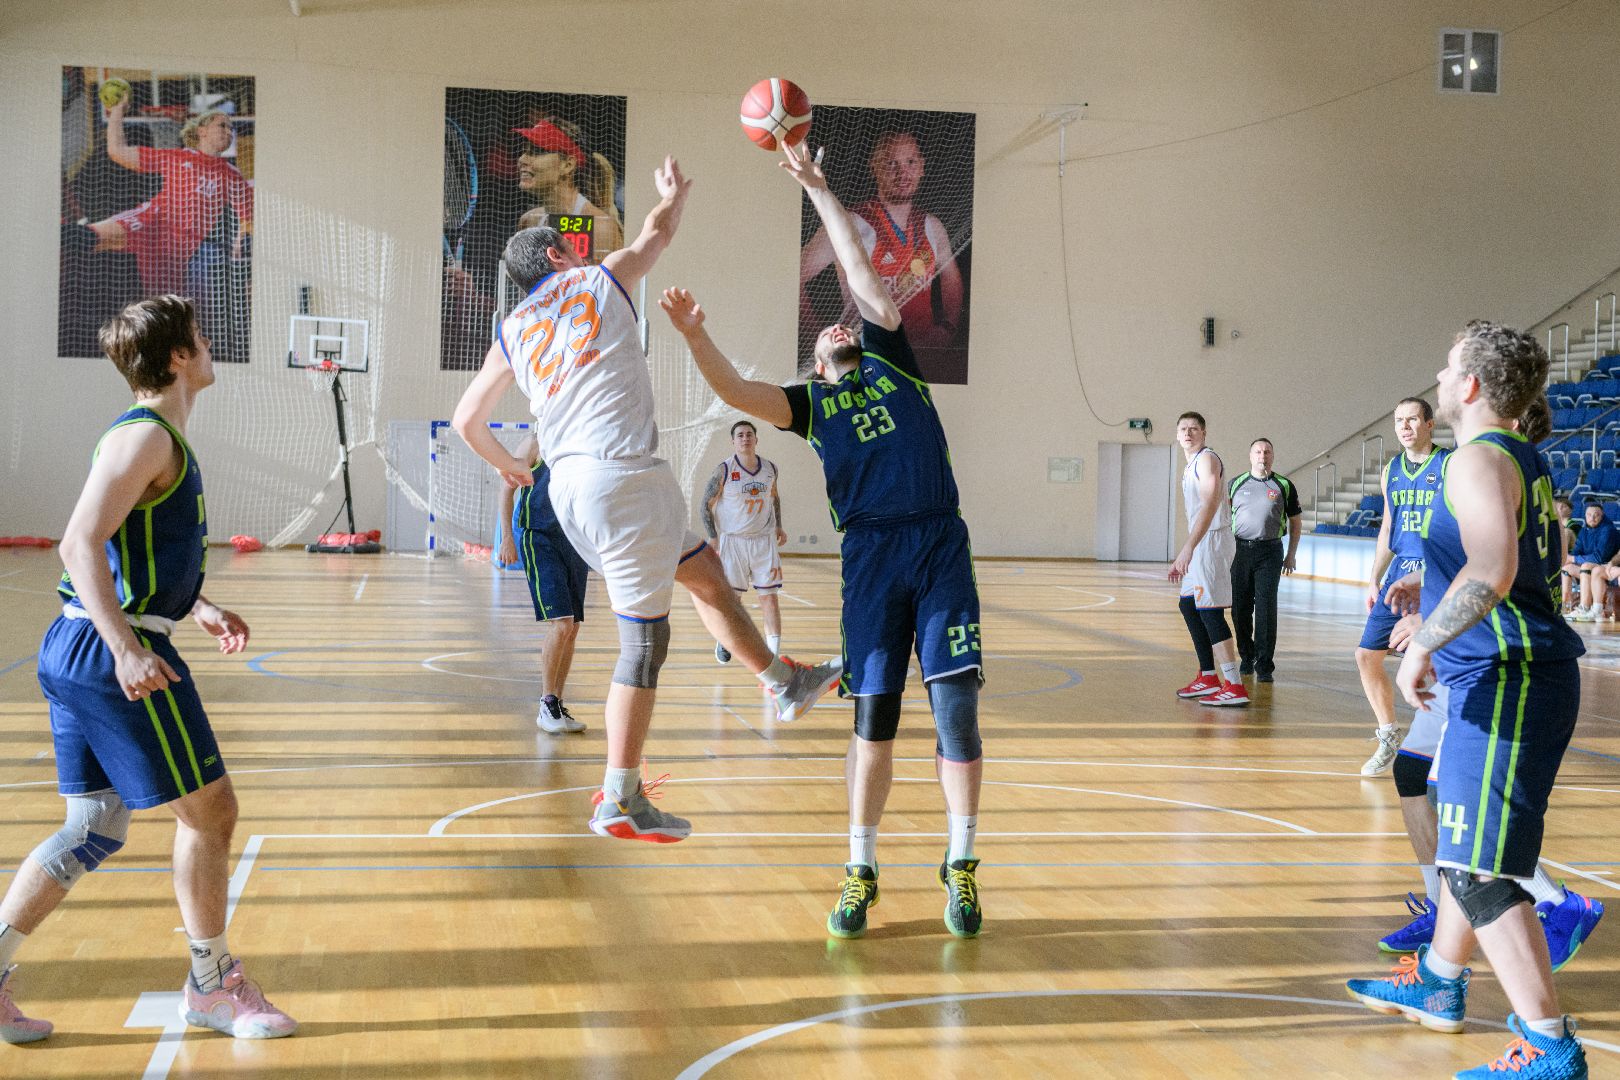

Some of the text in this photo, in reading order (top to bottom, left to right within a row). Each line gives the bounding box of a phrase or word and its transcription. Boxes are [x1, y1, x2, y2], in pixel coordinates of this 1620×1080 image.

[560, 217, 592, 231] 9:21
[520, 289, 602, 385] 23
[851, 405, 896, 443] 23
[745, 499, 765, 513] 77
[1402, 510, 1421, 532] 32
[1437, 802, 1469, 845] 4
